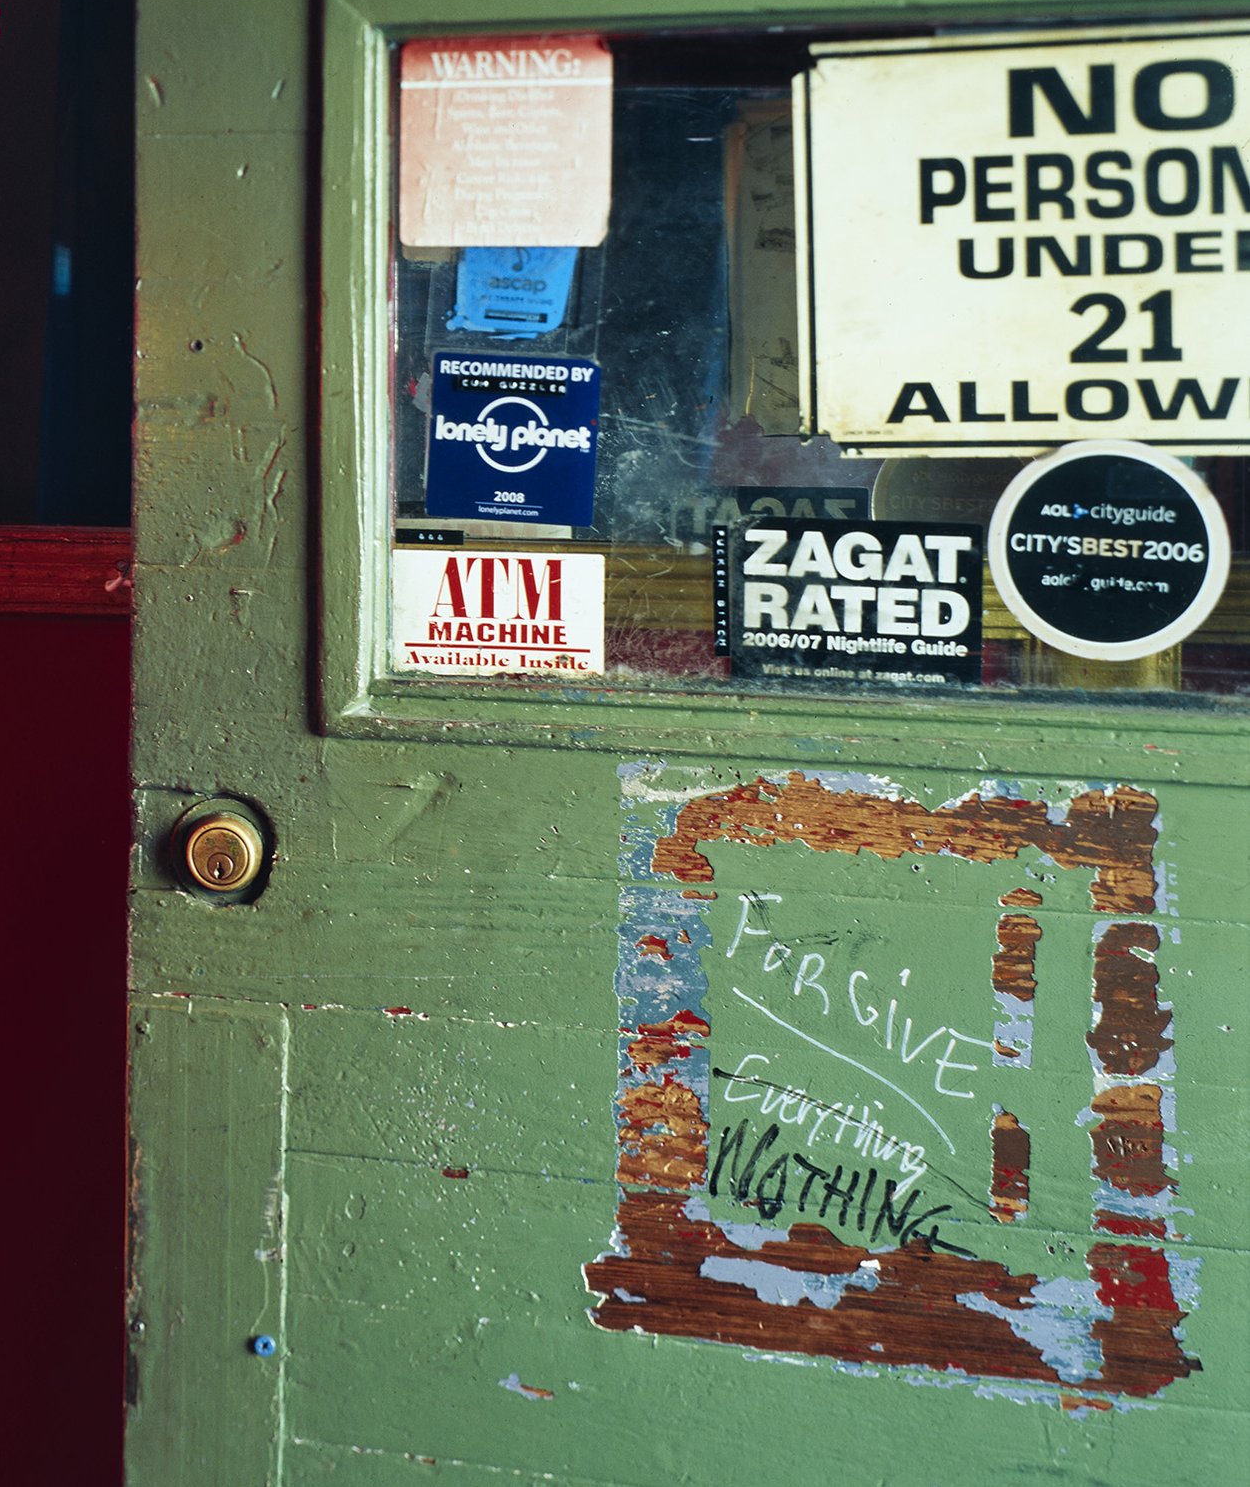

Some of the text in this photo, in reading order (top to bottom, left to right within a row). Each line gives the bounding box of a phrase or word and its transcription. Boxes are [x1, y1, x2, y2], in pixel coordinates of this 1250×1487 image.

[430, 49, 582, 79] WARNING:
[1008, 59, 1235, 138] NO
[957, 229, 1250, 280] UNDE
[489, 277, 547, 295] ascap
[1069, 289, 1183, 364] 21
[439, 359, 595, 383] RECOMMENDED BY
[885, 377, 1250, 424] ALLOW
[435, 414, 592, 452] lonely planet
[477, 505, 540, 517] lonelyplanet.com
[493, 490, 526, 504] 2008
[1040, 502, 1177, 526] AOL cityguide
[743, 528, 973, 584] ZAGAT
[429, 556, 566, 622] ATM
[743, 581, 971, 638] RATED
[428, 621, 568, 645] MACHINE
[741, 632, 969, 658] 2006/07 Nightlife Guide
[405, 650, 589, 671] Available Inside
[762, 663, 946, 684] Visit us online at zagat.com
[723, 1054, 927, 1198] Everything
[708, 1118, 978, 1259] NOTHING
